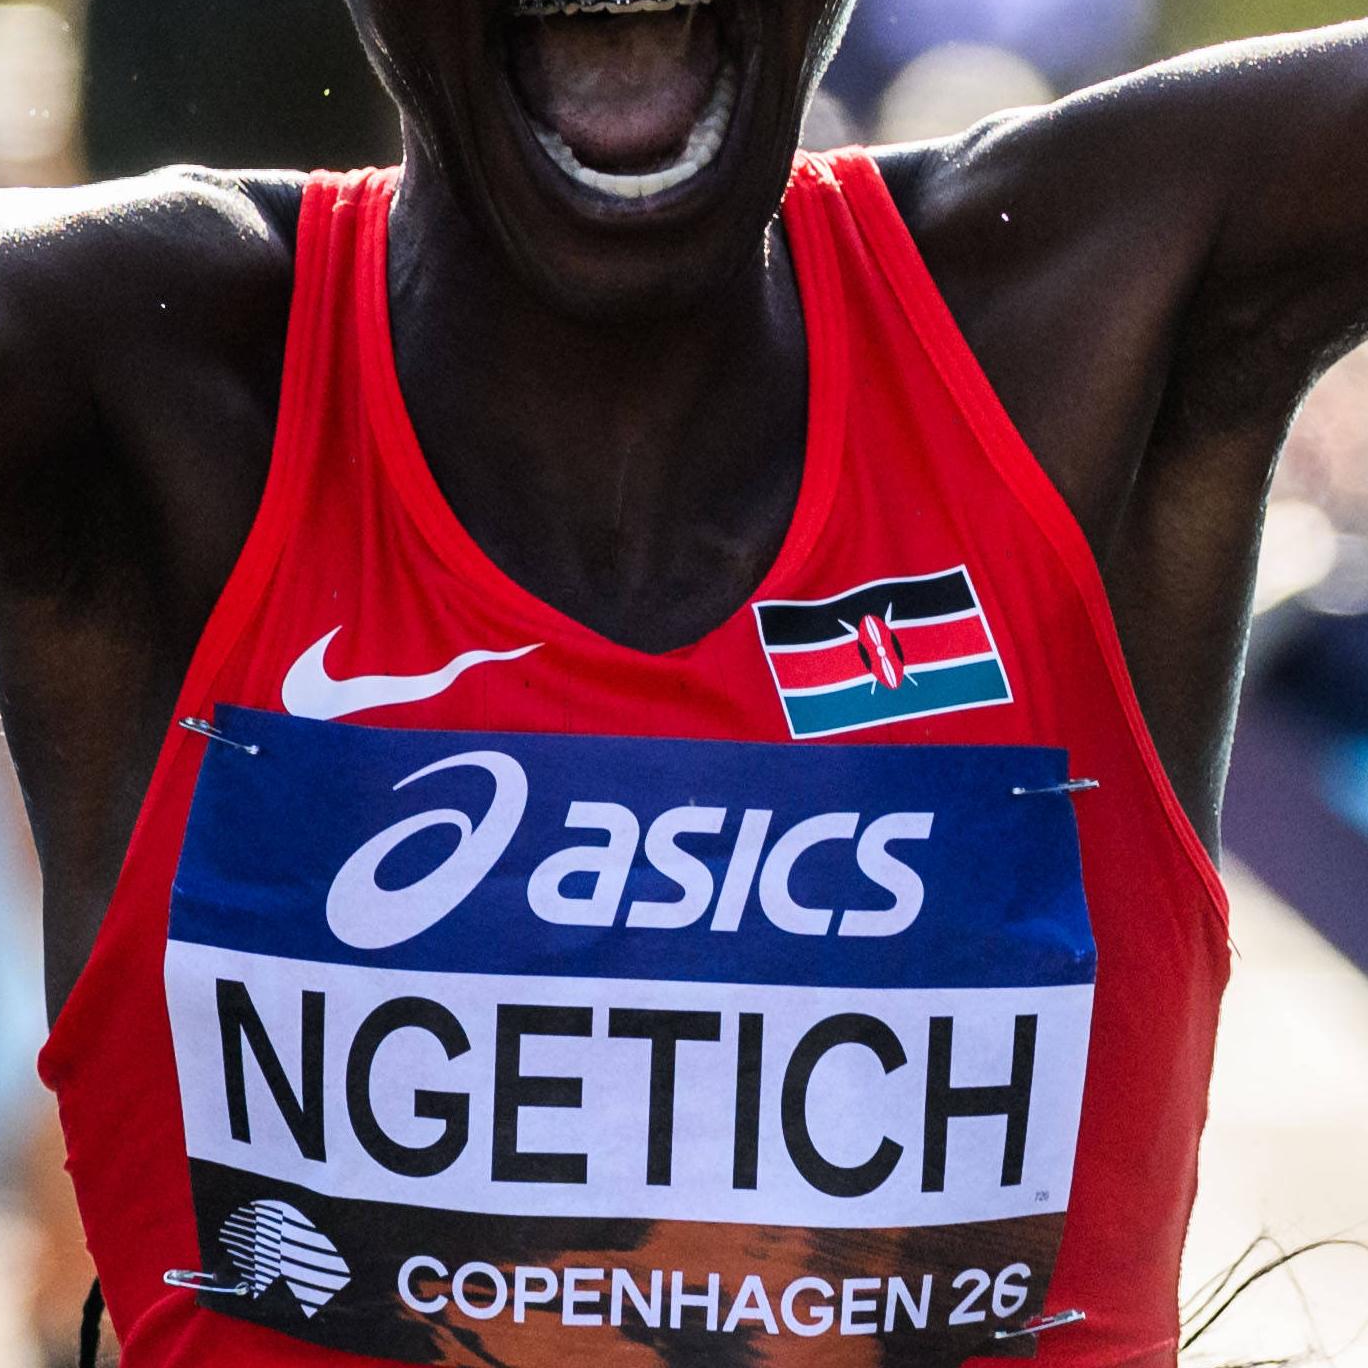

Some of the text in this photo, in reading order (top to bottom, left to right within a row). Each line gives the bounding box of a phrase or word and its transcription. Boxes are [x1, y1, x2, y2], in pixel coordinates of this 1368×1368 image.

[214, 978, 1039, 1199] NGETICH
[397, 1254, 1032, 1338] COPENHAGEN 26
